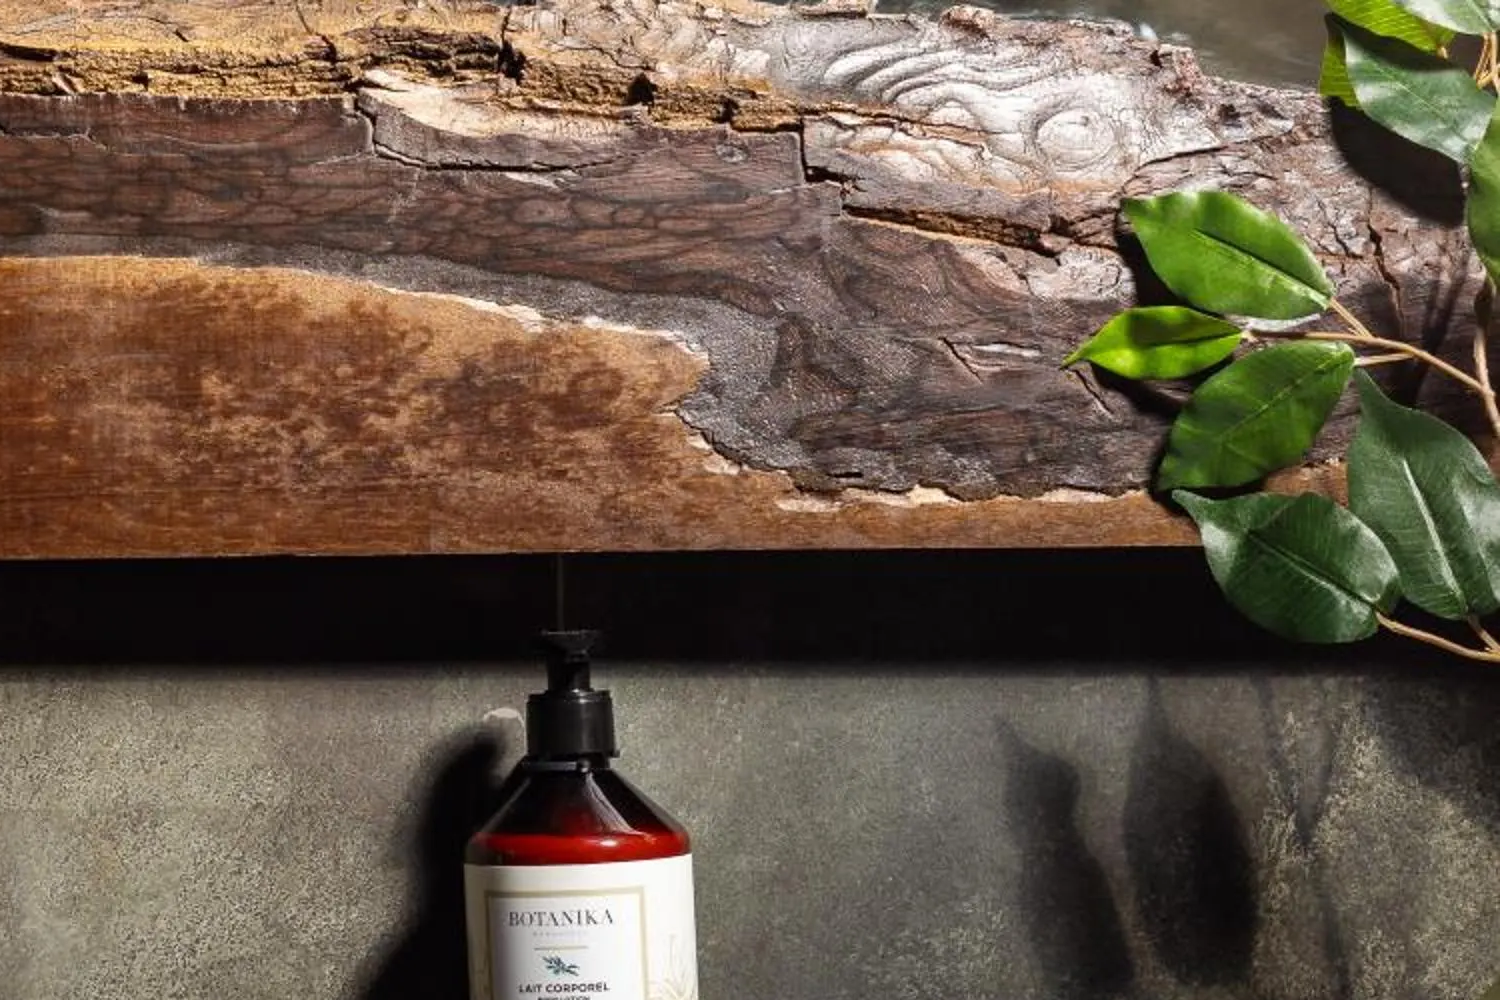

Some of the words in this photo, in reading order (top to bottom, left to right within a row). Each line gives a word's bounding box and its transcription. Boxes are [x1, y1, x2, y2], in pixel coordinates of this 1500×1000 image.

[509, 909, 613, 927] BOTANIKA
[518, 983, 542, 993] LAIT
[545, 982, 610, 993] CORPOREL
